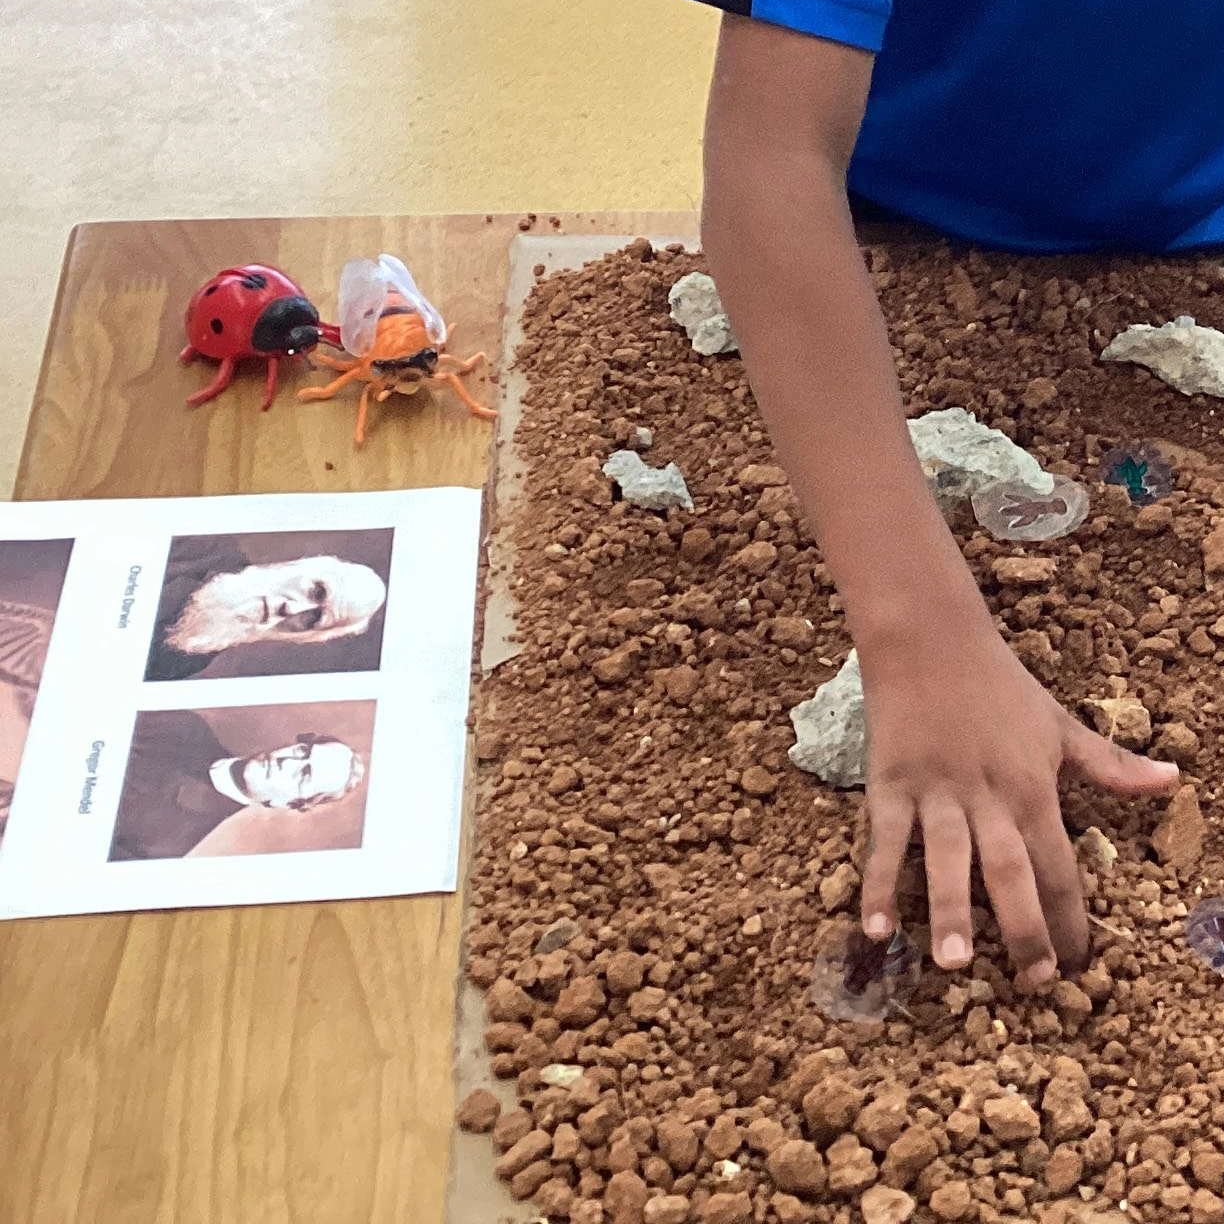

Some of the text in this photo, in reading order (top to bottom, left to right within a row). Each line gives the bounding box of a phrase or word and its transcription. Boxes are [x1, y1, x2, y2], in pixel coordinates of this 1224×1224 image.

[117, 564, 142, 629] Charles Darwin
[78, 740, 105, 815] Gregor Mendel
